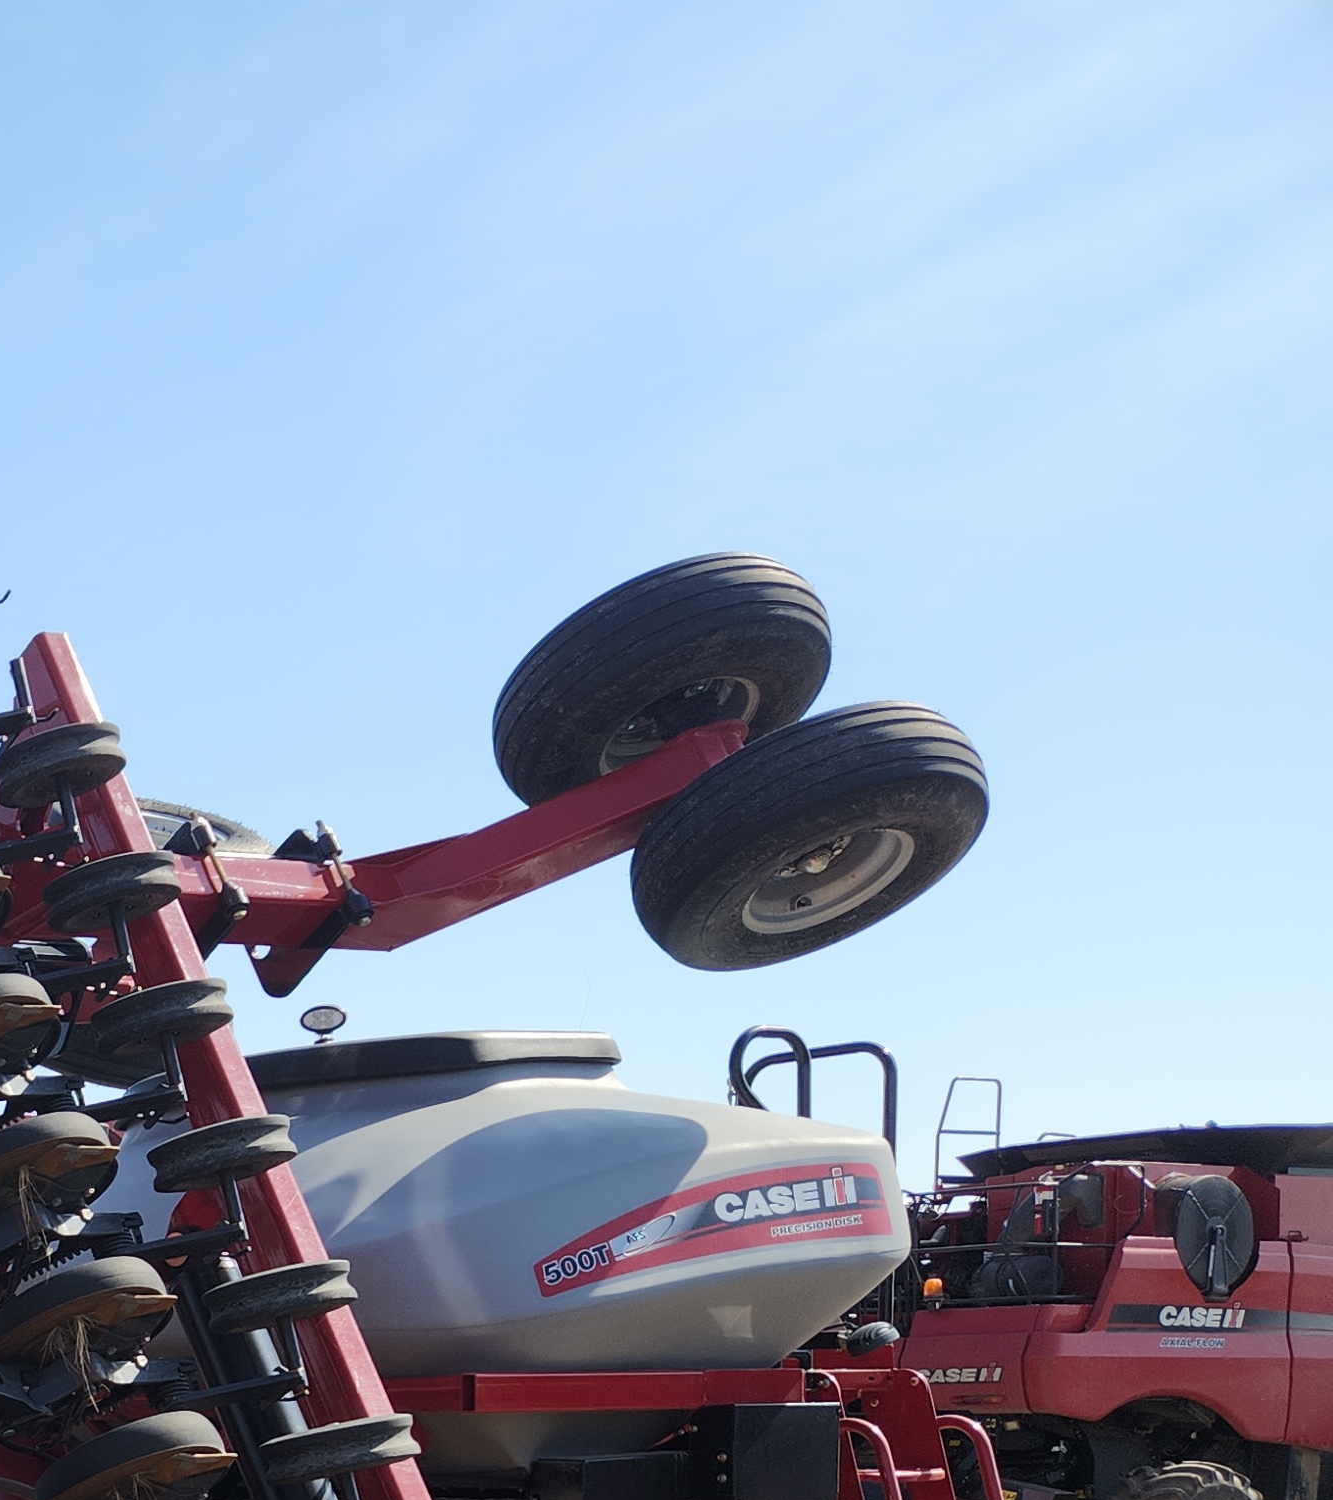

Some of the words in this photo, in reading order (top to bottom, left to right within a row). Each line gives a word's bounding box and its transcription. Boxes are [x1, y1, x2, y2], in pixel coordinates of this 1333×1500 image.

[714, 1180, 821, 1223] CASE
[625, 1228, 647, 1245] AFS
[771, 1219, 832, 1238] PRECISION
[833, 1213, 863, 1229] DISK
[542, 1243, 611, 1286] 500T
[1159, 1306, 1223, 1328] CASE
[1160, 1337, 1225, 1349] AXIAL-FLOW
